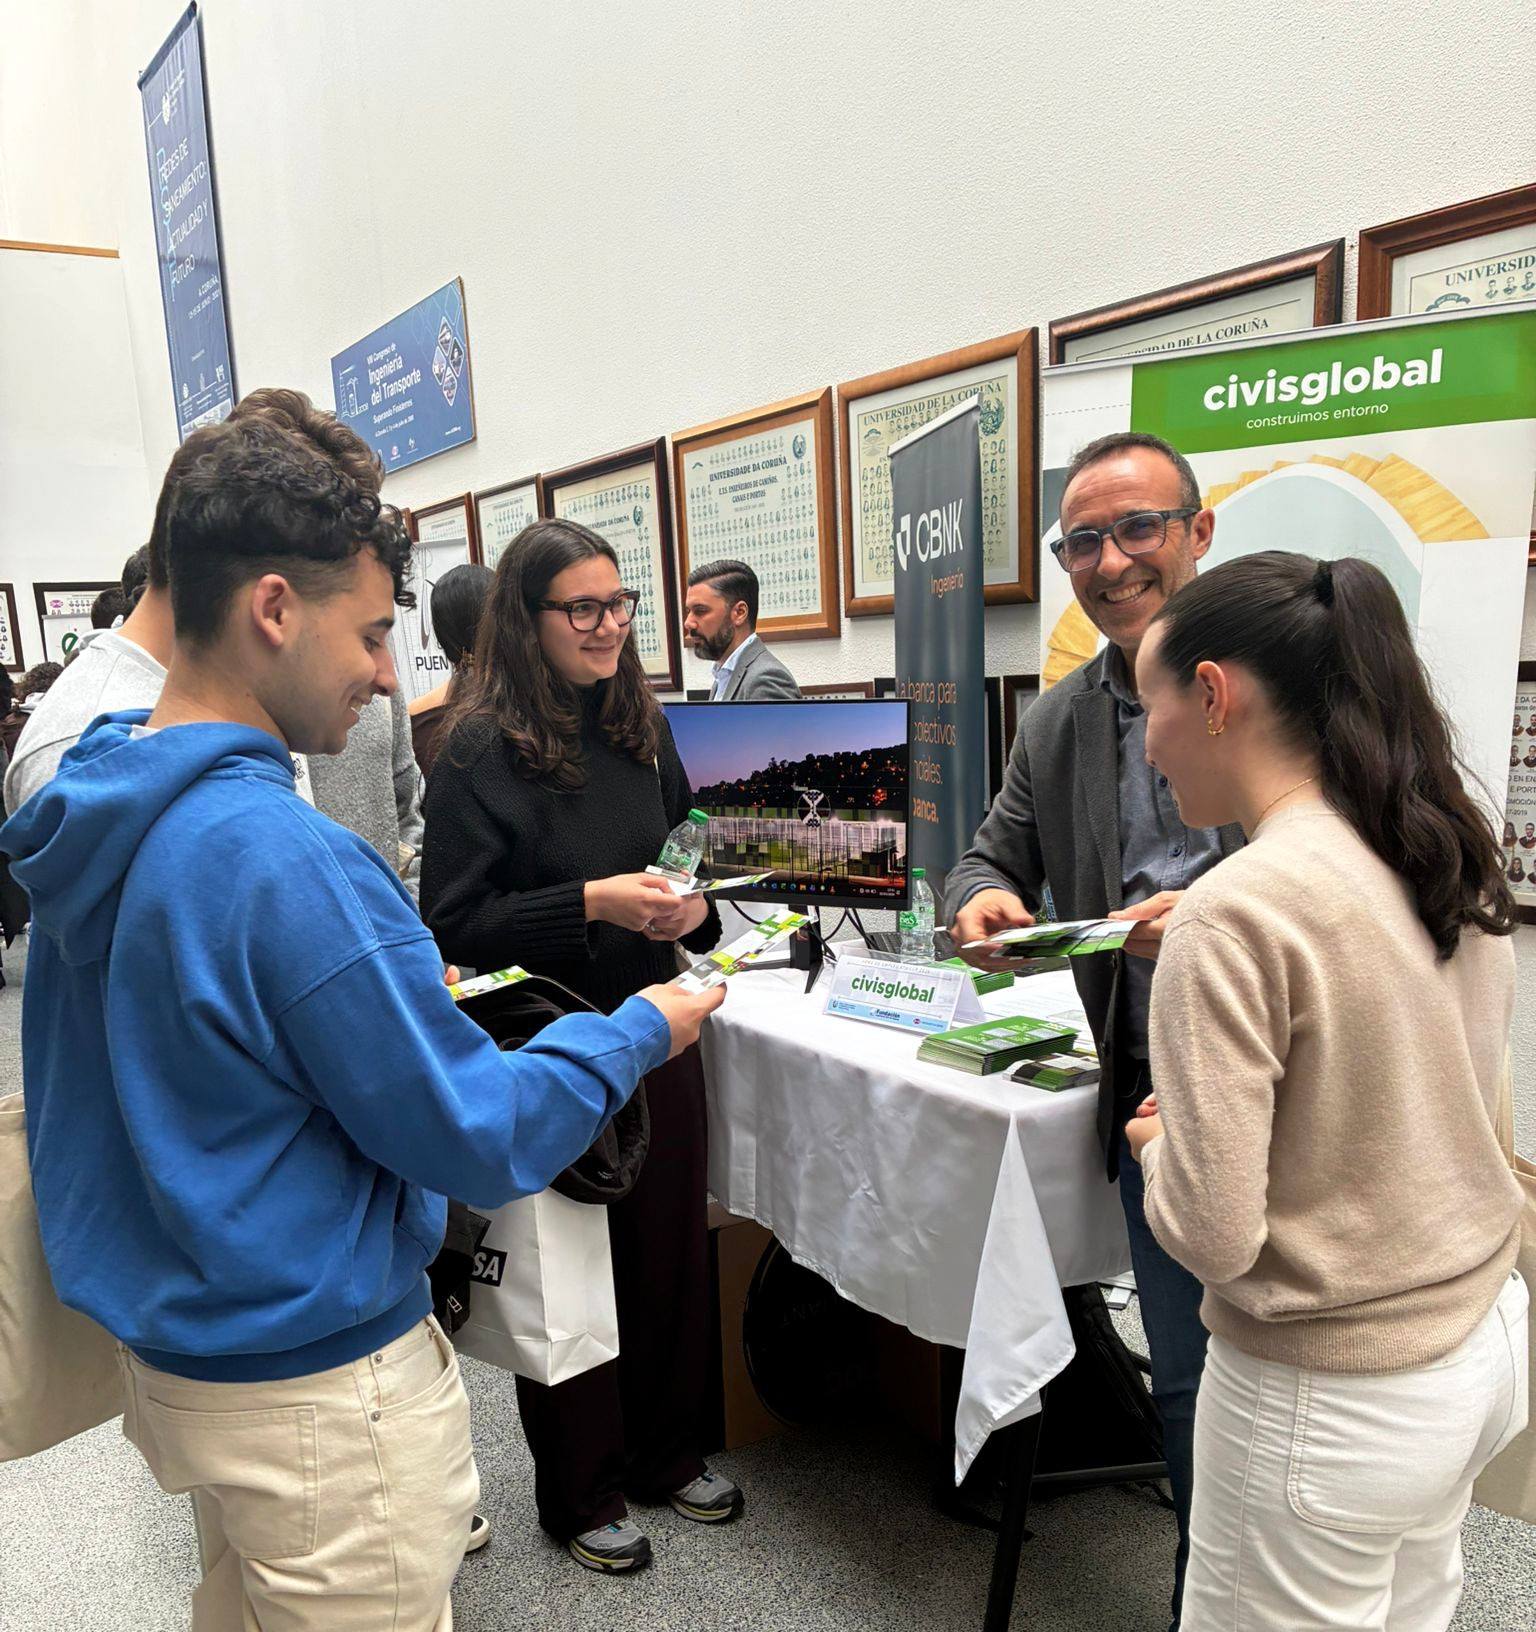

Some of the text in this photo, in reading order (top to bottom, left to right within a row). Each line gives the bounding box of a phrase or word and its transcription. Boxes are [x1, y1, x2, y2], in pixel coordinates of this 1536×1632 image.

[1197, 331, 1212, 344] LA
[1215, 317, 1269, 340] CORUÑA
[368, 352, 403, 386] Ingeniería
[1203, 348, 1443, 411] civisglobal
[371, 367, 421, 406] del Transporte
[863, 401, 926, 426] UNIVERSIDAD
[927, 396, 940, 410] DE
[942, 394, 955, 406] LA
[1246, 403, 1389, 429] construimos entorno
[709, 464, 751, 482] UNIVERSIDADE
[916, 498, 963, 563] CBNK
[851, 974, 935, 1003] civisglobal
